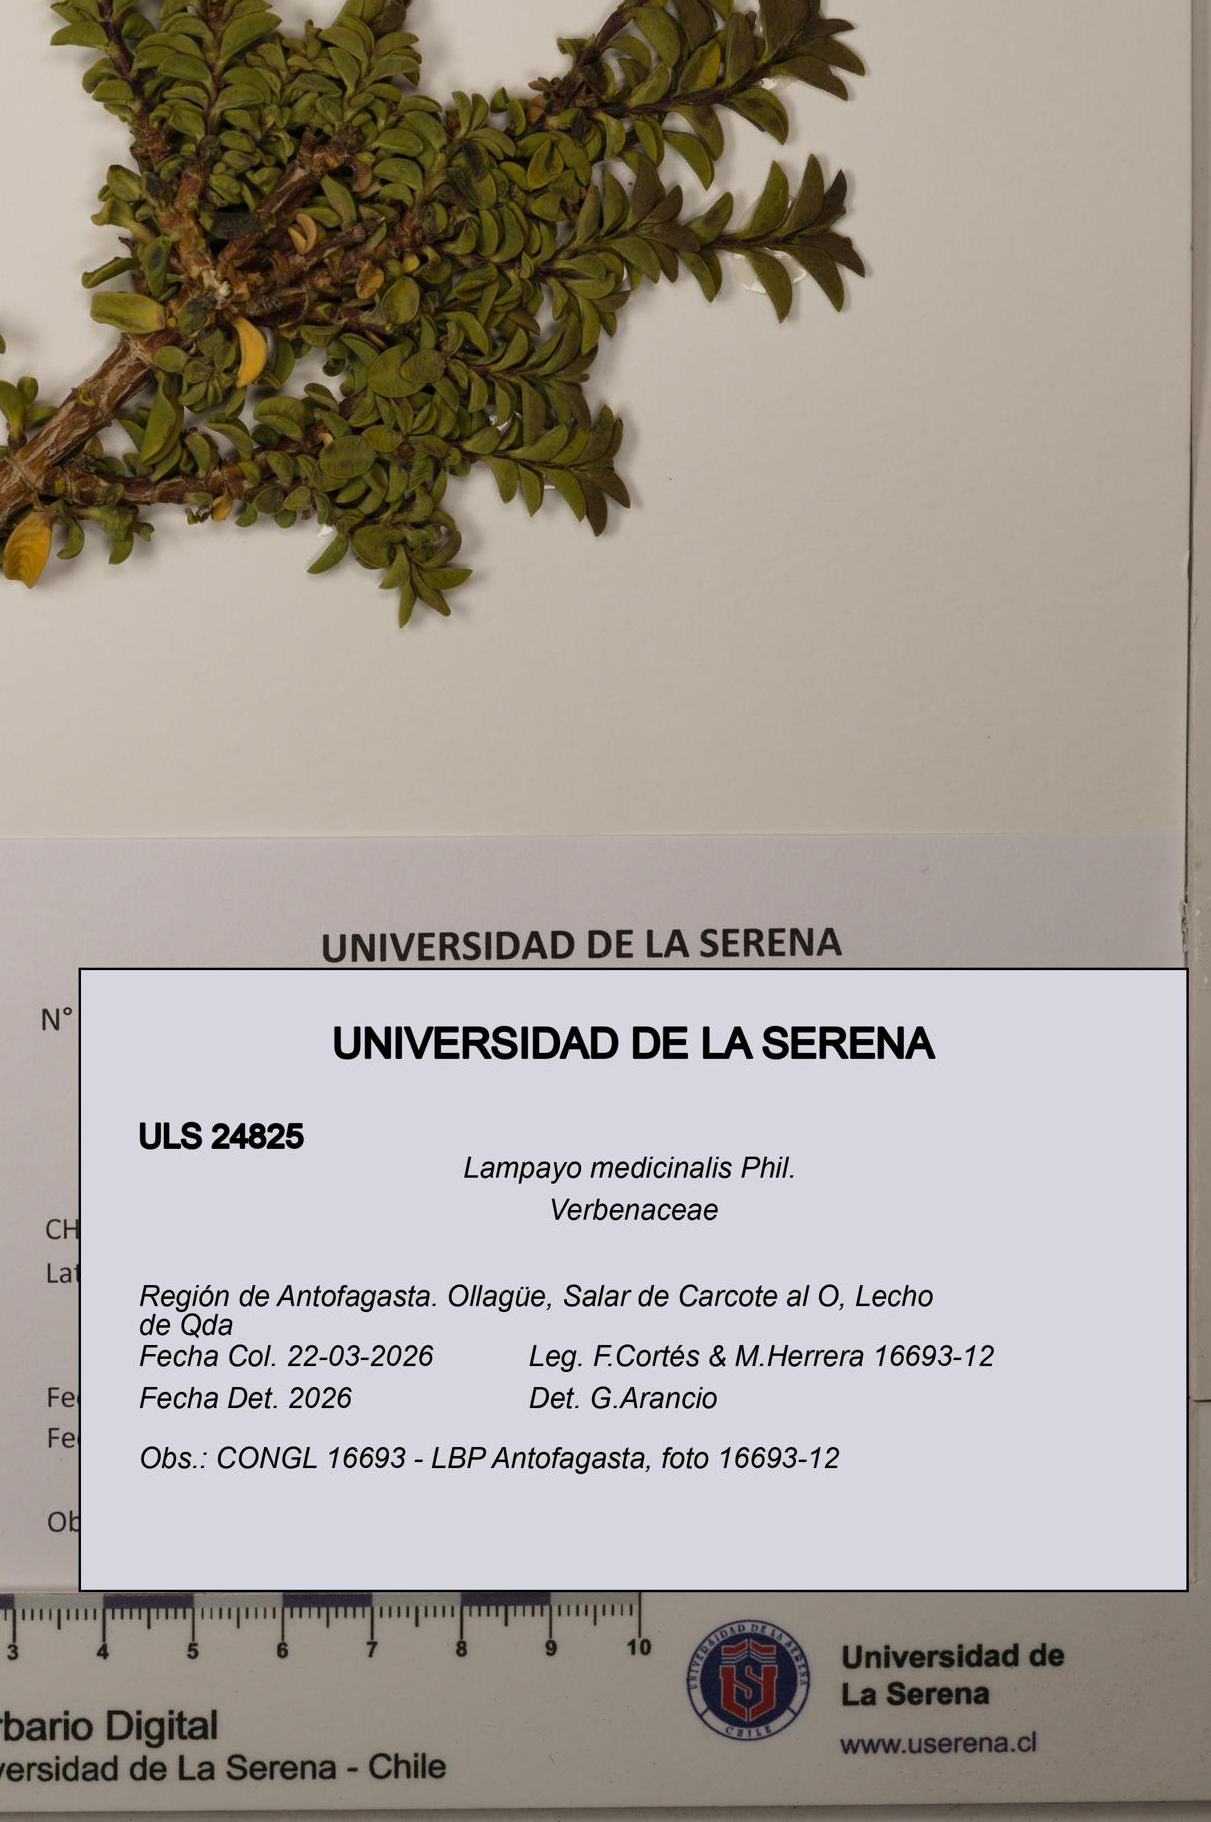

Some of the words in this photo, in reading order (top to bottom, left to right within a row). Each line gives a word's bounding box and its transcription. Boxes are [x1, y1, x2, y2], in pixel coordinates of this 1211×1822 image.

[322, 930, 575, 964] UNIVERSIDAD
[587, 929, 634, 959] DE
[646, 928, 690, 959] LA
[699, 927, 843, 959] SERENA
[48, 1386, 79, 1408] Fe
[48, 1427, 79, 1448] Fe
[7, 1644, 19, 1662] 3
[96, 1643, 110, 1661] 4
[186, 1643, 200, 1660] 5
[276, 1642, 289, 1660] 6
[366, 1641, 379, 1659] 7
[455, 1640, 468, 1658] 8
[544, 1639, 558, 1657] 9
[626, 1639, 652, 1657] 10
[842, 1642, 1020, 1670] Universidad
[1028, 1642, 1065, 1668] de
[841, 1682, 877, 1707] La
[886, 1681, 990, 1706] Serena
[106, 1709, 219, 1747] Digital
[839, 1730, 1037, 1755] www.userena.cl
[129, 1754, 168, 1782] de
[178, 1754, 216, 1782] La
[225, 1753, 337, 1782] Serena
[346, 1765, 359, 1773] -
[368, 1752, 447, 1780] Chile
